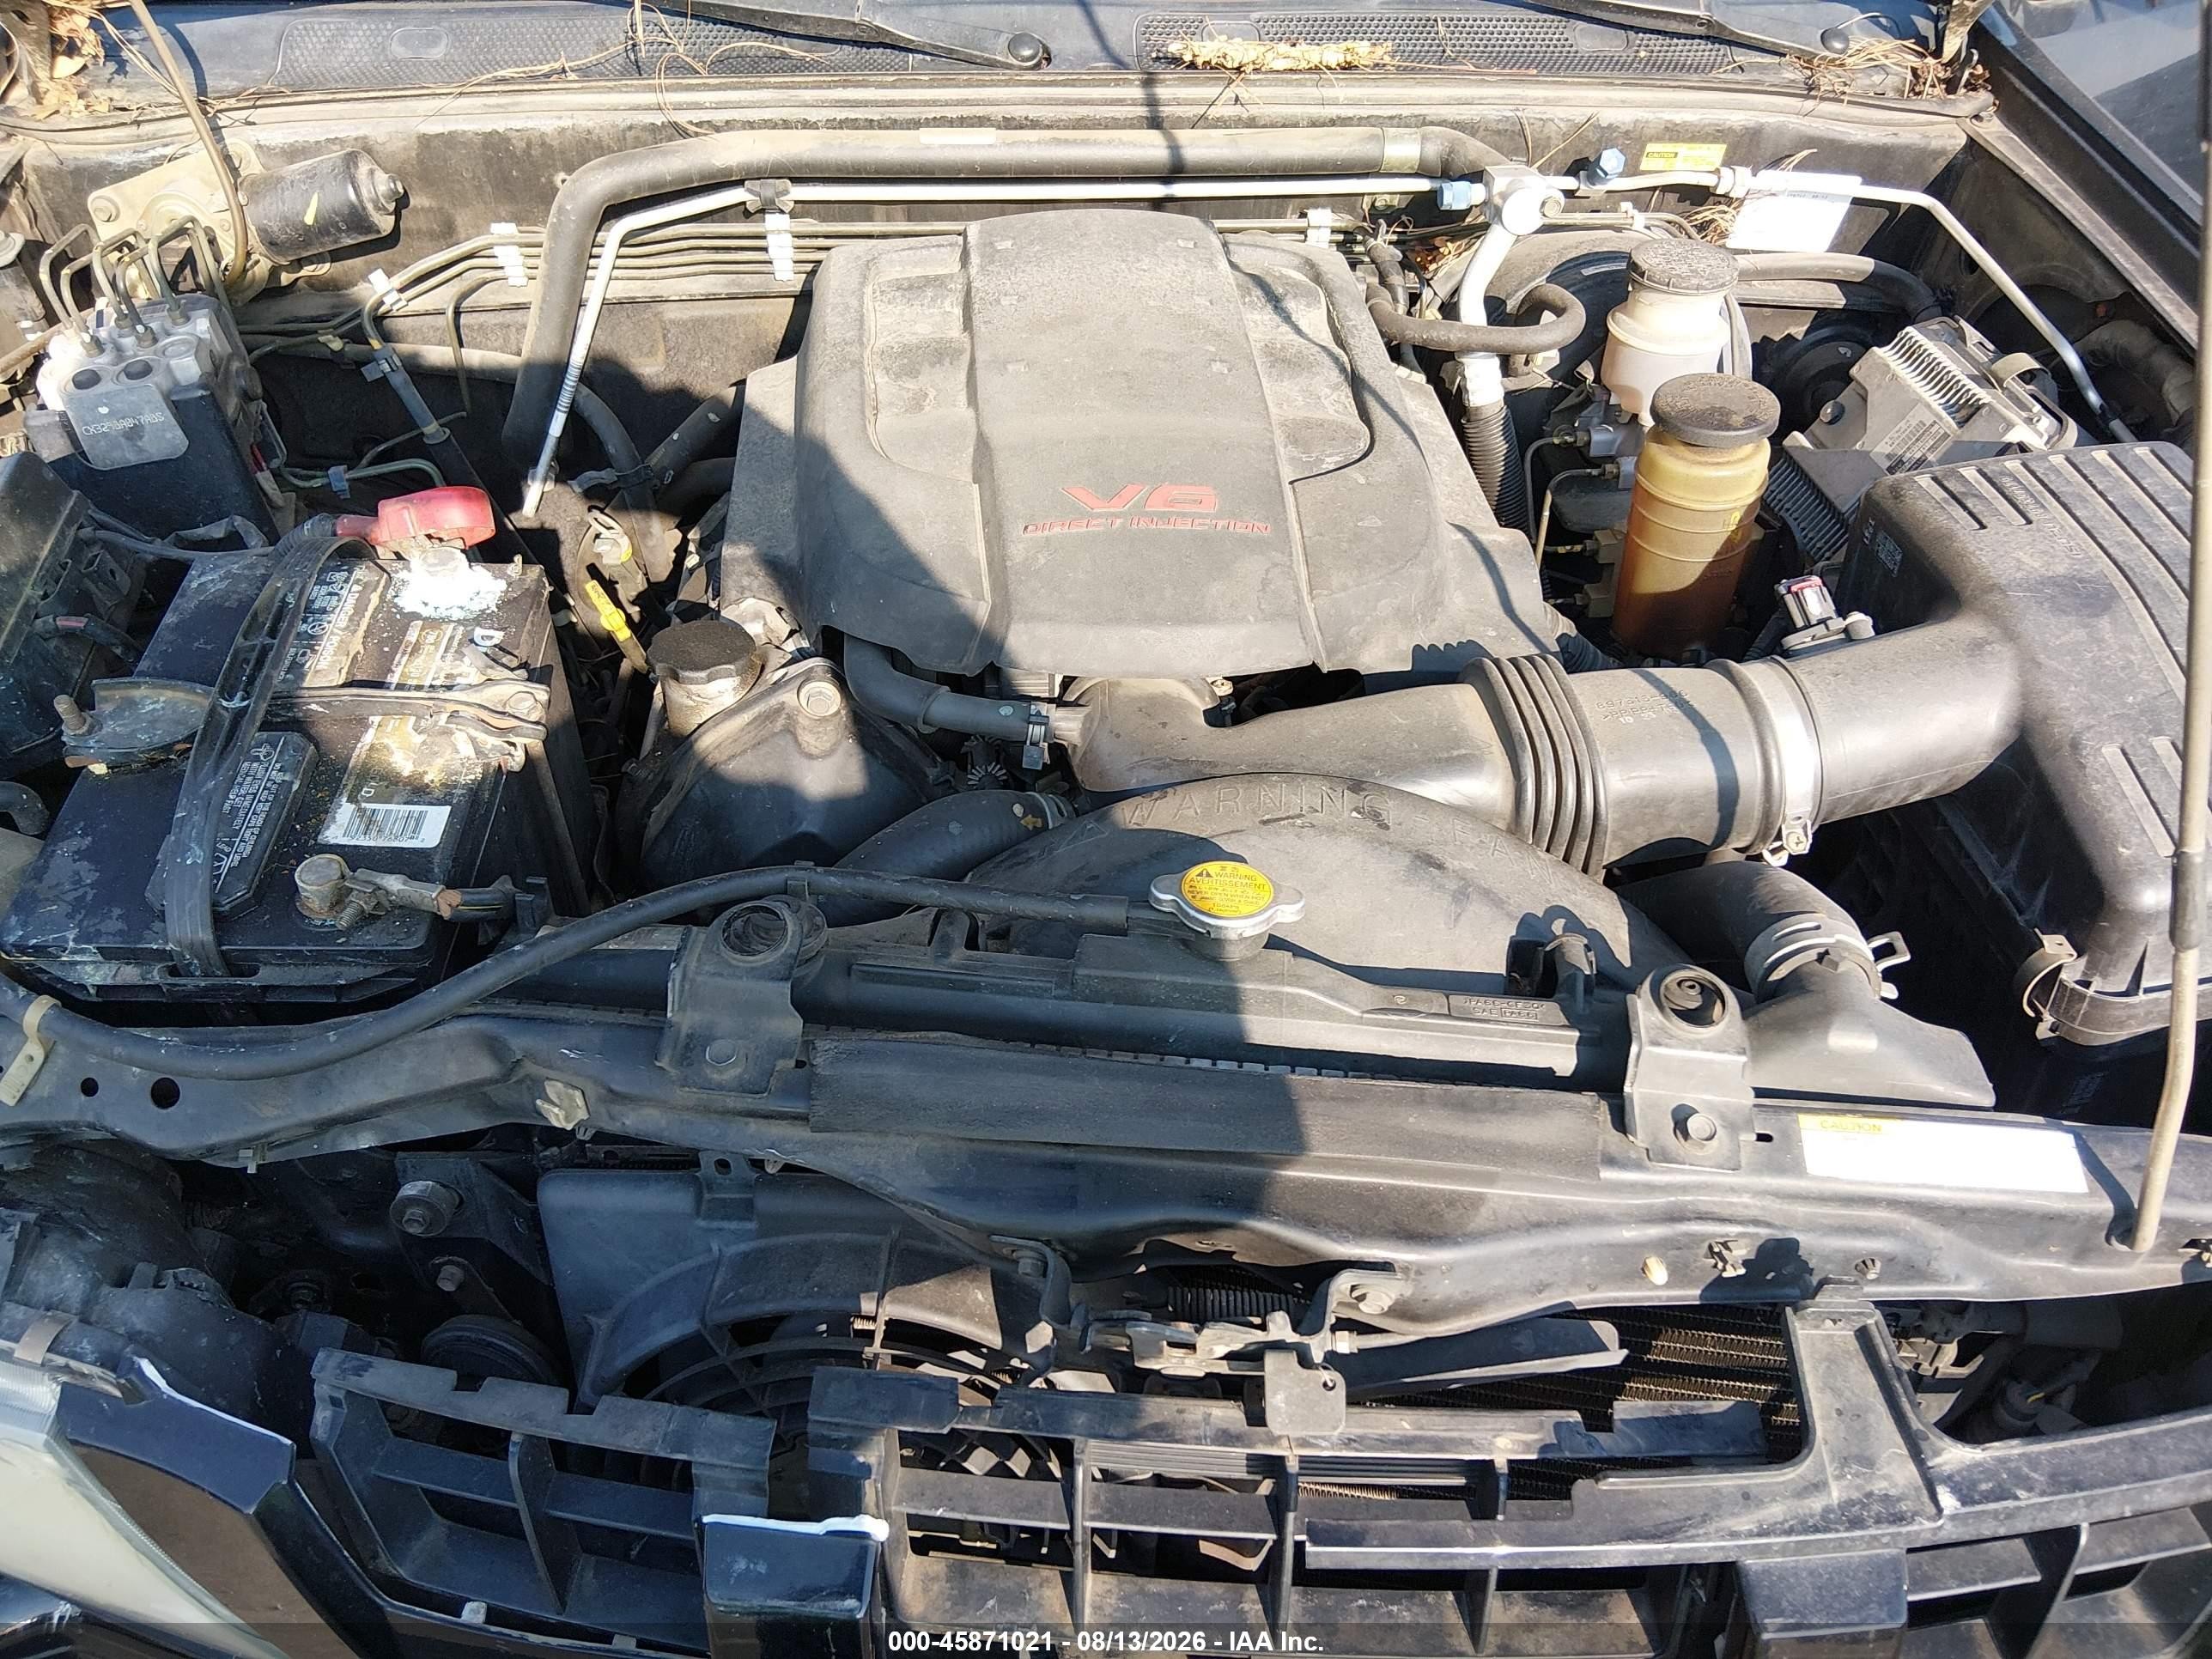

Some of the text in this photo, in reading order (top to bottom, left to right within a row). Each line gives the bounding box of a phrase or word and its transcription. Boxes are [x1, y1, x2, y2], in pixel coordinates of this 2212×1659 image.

[1060, 483, 1218, 512] V6
[1022, 517, 1272, 536] DIRECT INJECTION
[335, 592, 359, 629] DANGER
[315, 635, 341, 670] POISON
[247, 761, 260, 775] WITH
[228, 785, 240, 799] HELP
[248, 780, 261, 793] EYES
[222, 799, 234, 814] FAST
[233, 797, 244, 808] GET
[232, 794, 255, 830] IMMEDIATELY
[1119, 785, 1393, 830] WARNING
[1451, 817, 1556, 888] FAN
[1189, 878, 1267, 890] AVERTISSEMENT
[1215, 872, 1257, 882] WARNING
[1472, 1007, 1534, 1018] SAE PA66
[1820, 1120, 1882, 1133] CAUTION
